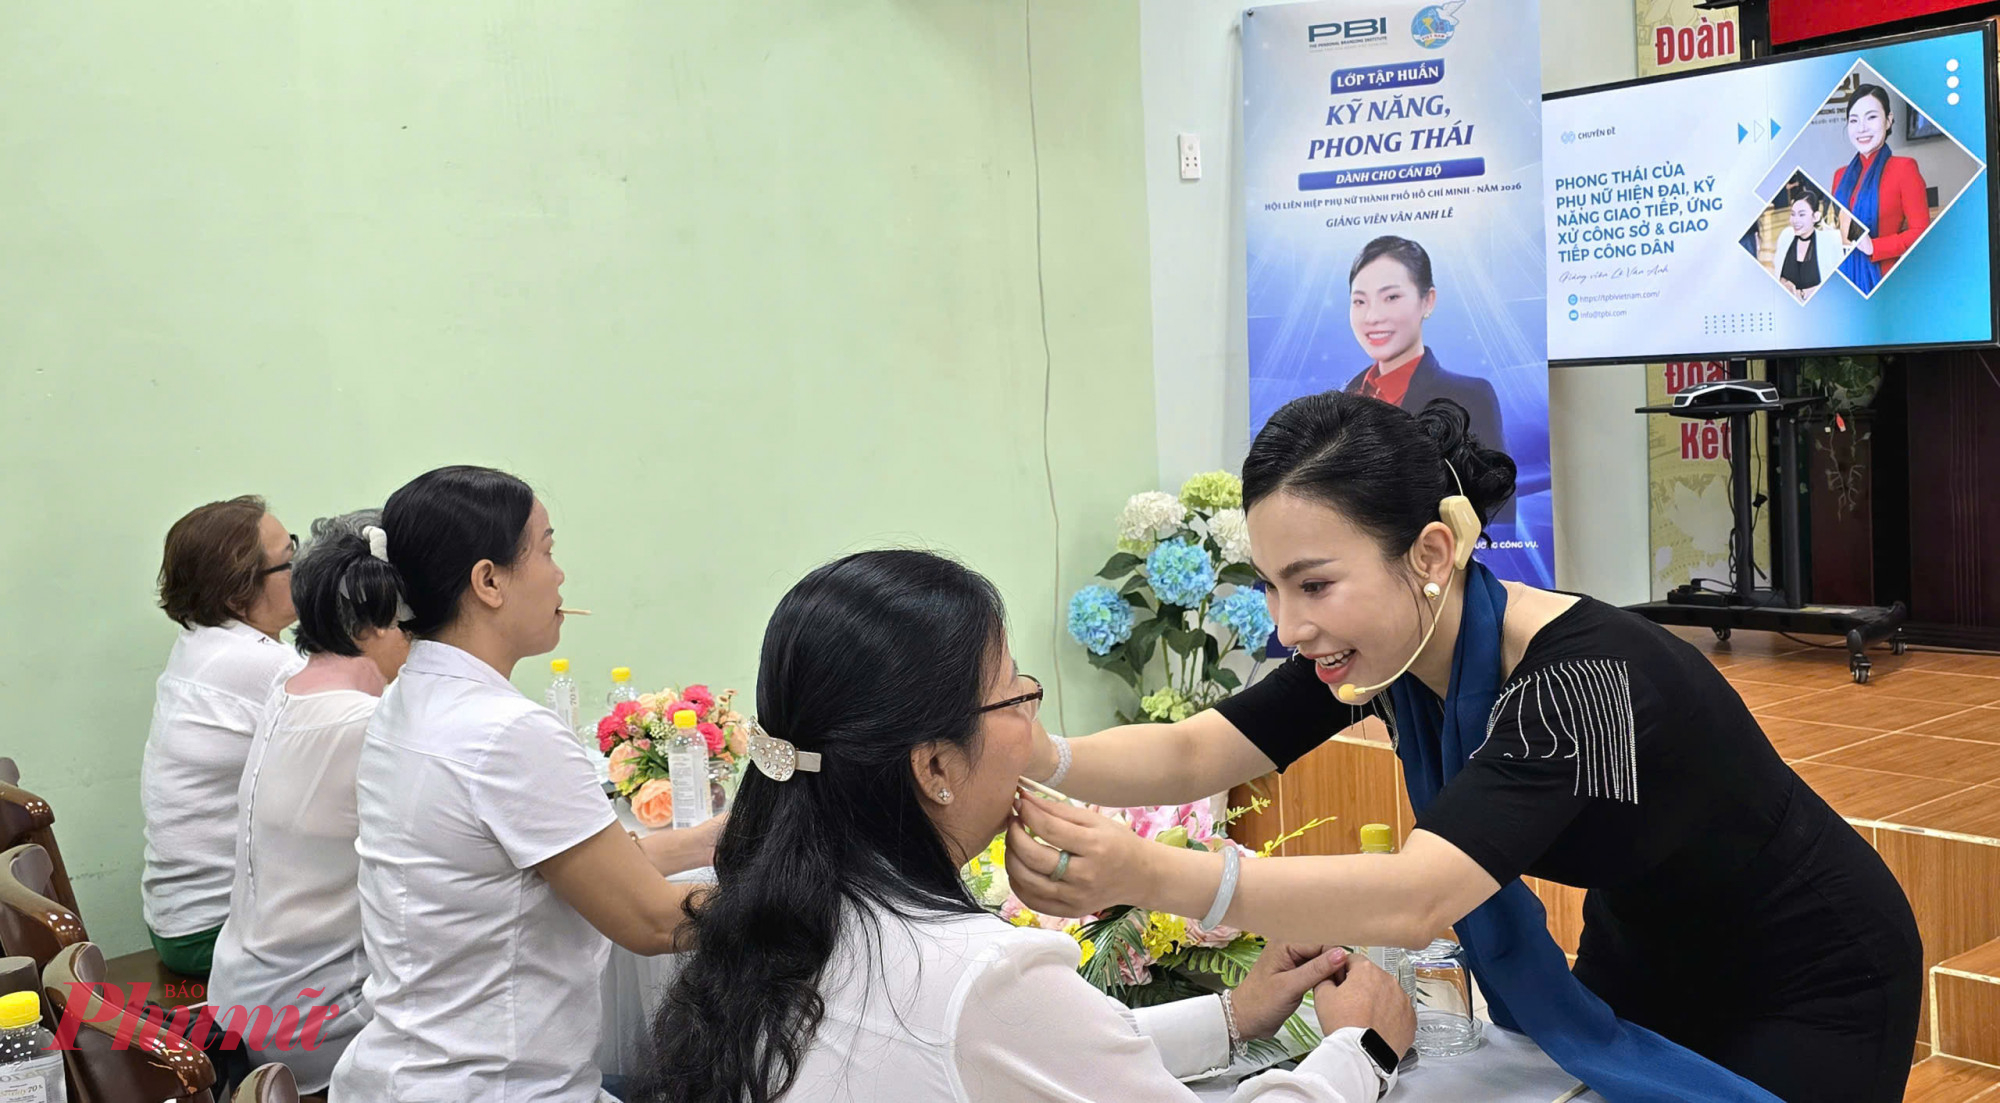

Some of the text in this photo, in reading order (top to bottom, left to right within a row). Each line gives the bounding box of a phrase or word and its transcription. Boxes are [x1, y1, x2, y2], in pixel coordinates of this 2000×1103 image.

[1308, 17, 1387, 42] PBI
[1655, 17, 1736, 65] Đoàn
[1337, 62, 1439, 88] LỚP TẬP HUẤN
[1326, 94, 1451, 126] KỸ NĂNG,
[1307, 119, 1475, 160] PHONG THÁI
[1578, 129, 1606, 140] CHUYÊN
[1336, 163, 1442, 185] DÀNH CHO CÁN BỘ
[1555, 161, 1685, 191] PHONG THÁI CỦA
[1265, 201, 1281, 212] HỘI
[1283, 200, 1302, 209] LIÊN
[1303, 198, 1323, 209] HIỆP
[1359, 193, 1389, 203] THÀNH
[1428, 187, 1443, 197] CHÍ
[1445, 187, 1470, 196] MINH
[1477, 183, 1499, 194] NĂM
[1500, 182, 1522, 191] 2026
[1556, 175, 1716, 210] PHỤ NỮ HIỆN ĐẠI, KỸ
[1363, 213, 1388, 224] VIÊN
[1390, 210, 1413, 222] VÂN
[1414, 208, 1440, 221] ANH
[1441, 207, 1454, 218] LÊ
[1557, 197, 1723, 227] NĂNG GIAO TIẾP, ỨNG
[1558, 218, 1709, 245] XỬ CÔNG SỞ & GIAO
[1558, 238, 1675, 262] TIẾP CÔNG DÂN
[1499, 539, 1524, 549] CÔNG
